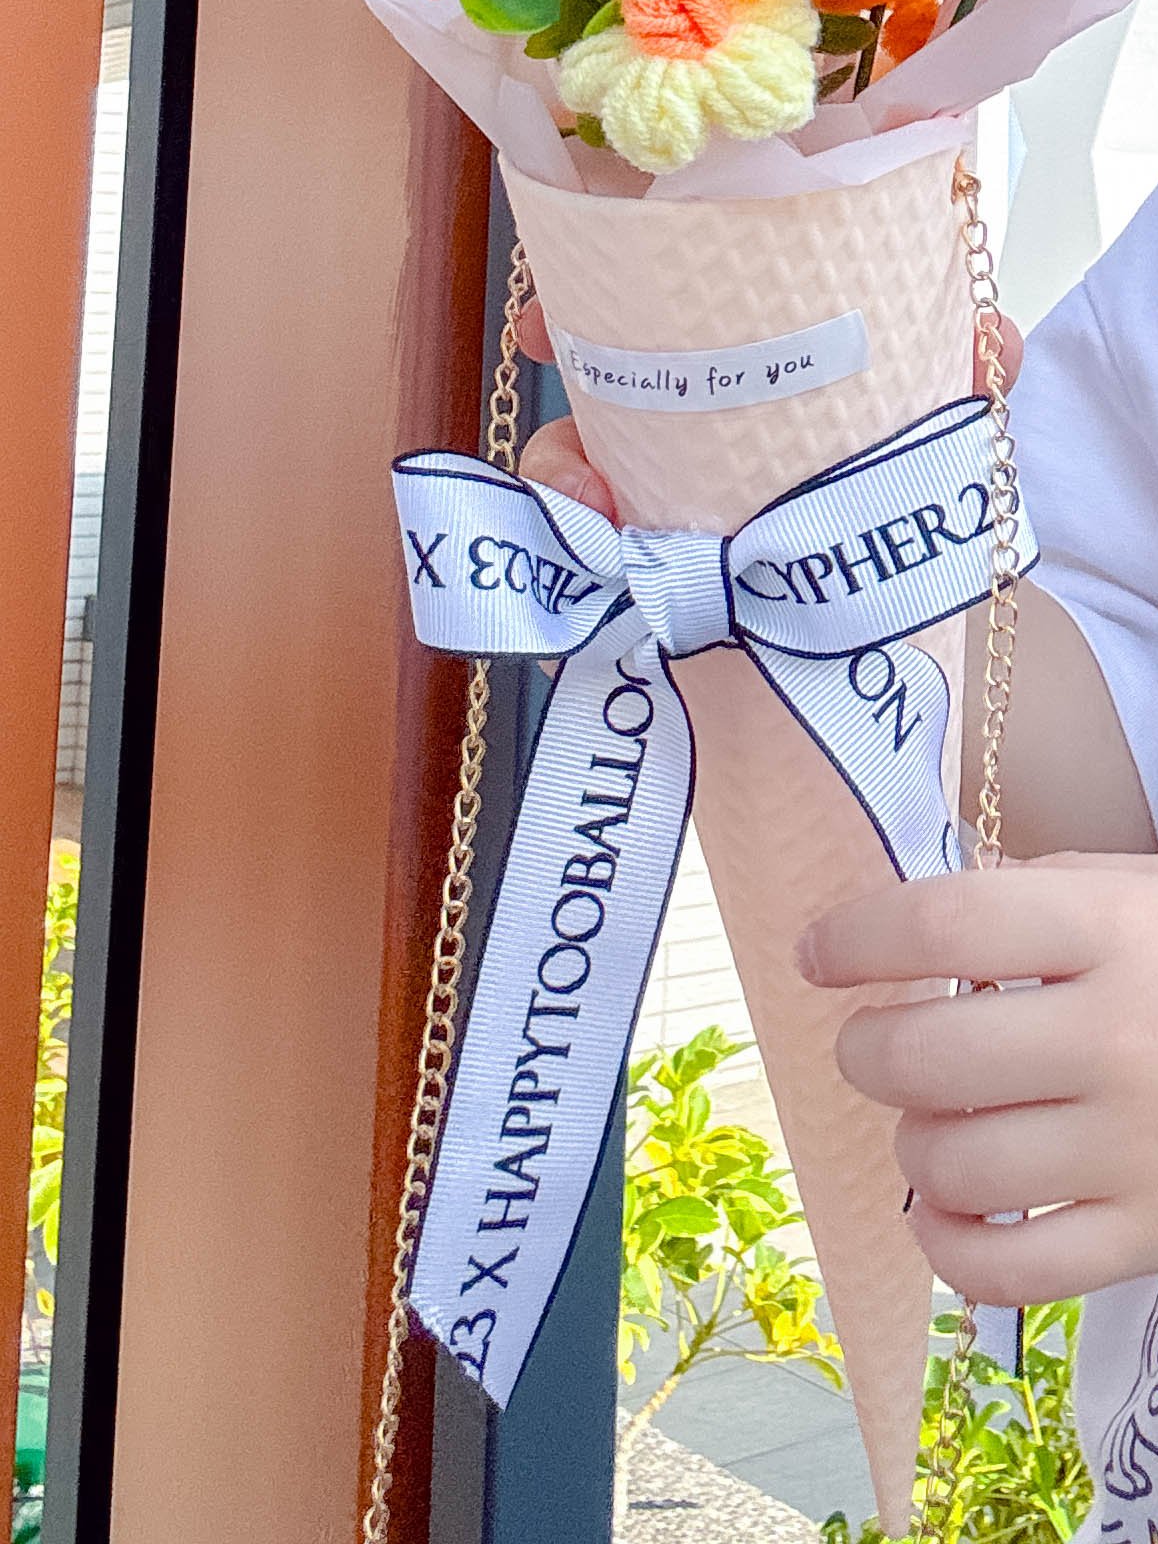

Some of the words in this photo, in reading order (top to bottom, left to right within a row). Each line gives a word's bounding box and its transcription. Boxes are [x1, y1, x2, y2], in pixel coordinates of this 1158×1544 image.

[570, 350, 688, 397] Especially
[706, 366, 746, 396] for
[766, 354, 815, 386] you
[406, 528, 449, 589] X
[460, 1246, 521, 1297] X
